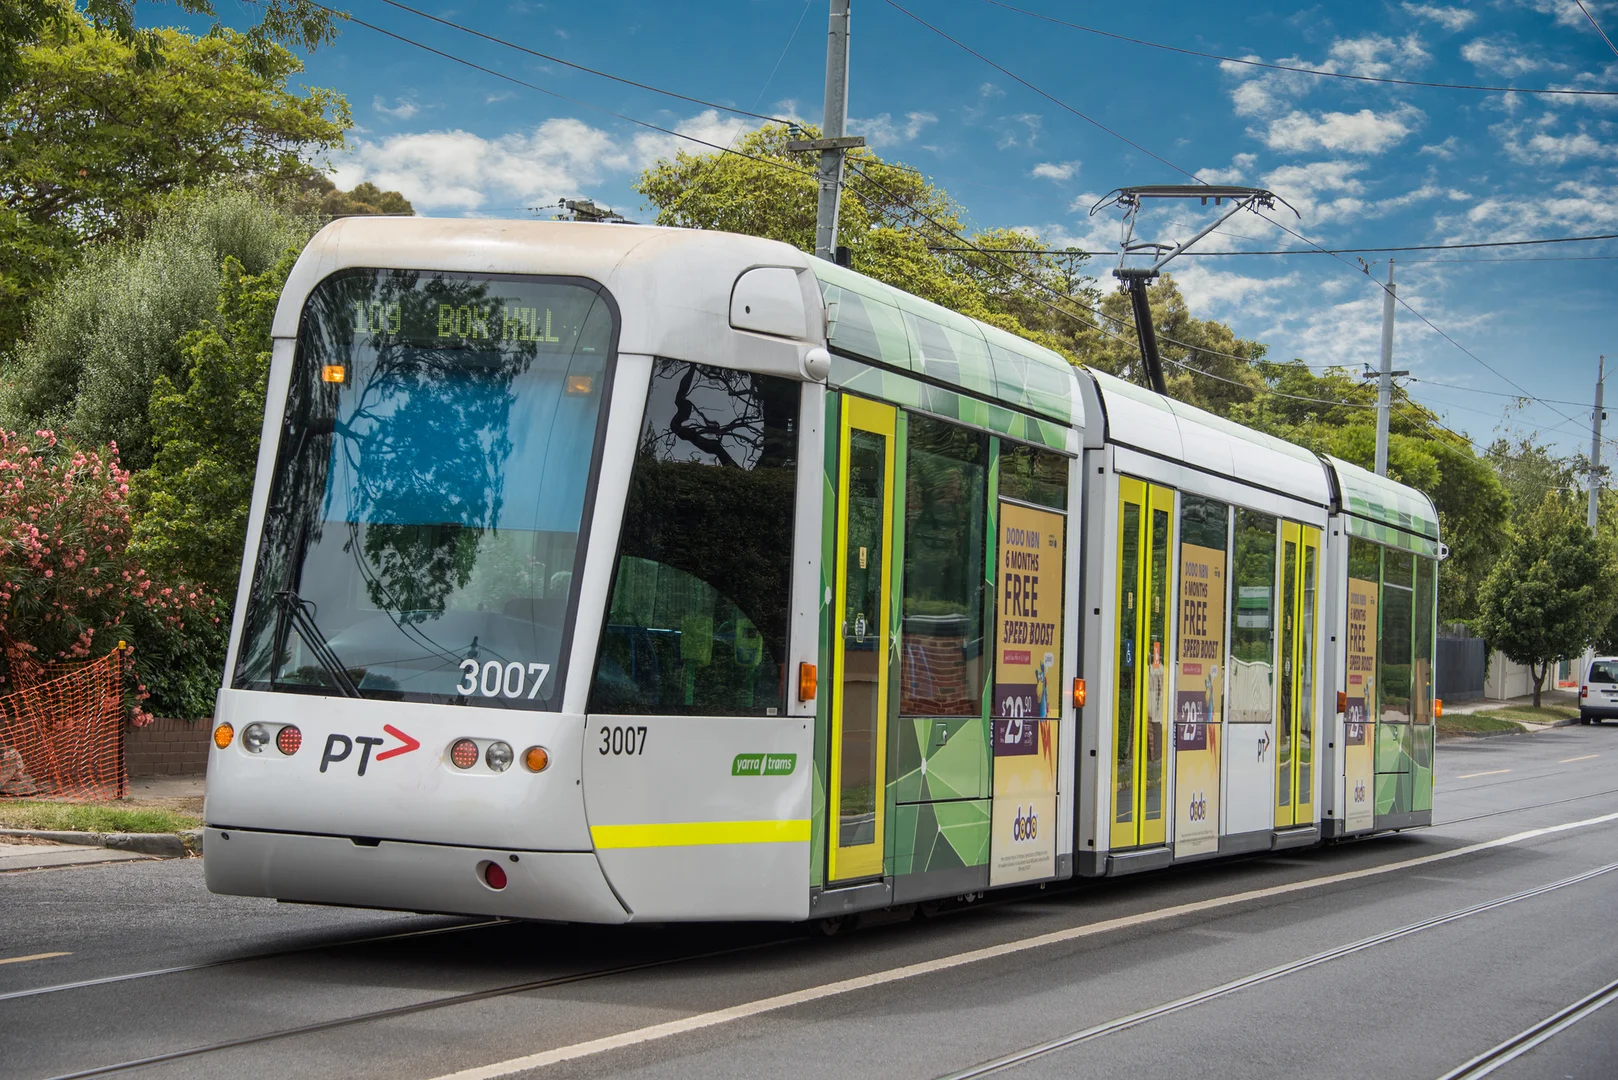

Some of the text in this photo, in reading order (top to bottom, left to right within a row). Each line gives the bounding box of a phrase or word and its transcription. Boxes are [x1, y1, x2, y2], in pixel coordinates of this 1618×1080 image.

[353, 300, 560, 342] 109 BOX HILL
[1006, 527, 1025, 547] DODO
[1026, 530, 1040, 549] NBN
[1005, 550, 1039, 572] 6 MONTHS
[1004, 573, 1039, 618] FREE
[1188, 581, 1208, 598] MONTHS
[1183, 599, 1207, 636] FREE
[1003, 620, 1055, 646] SPEED BOOST
[1350, 623, 1366, 653] FREE
[1183, 639, 1218, 659] SPEED BOOST
[456, 658, 550, 700] 3007
[319, 733, 384, 777] PT
[599, 726, 648, 755] 3007
[736, 756, 792, 773] yarra trams
[1190, 792, 1206, 821] dodo
[1014, 805, 1037, 841] dodo
